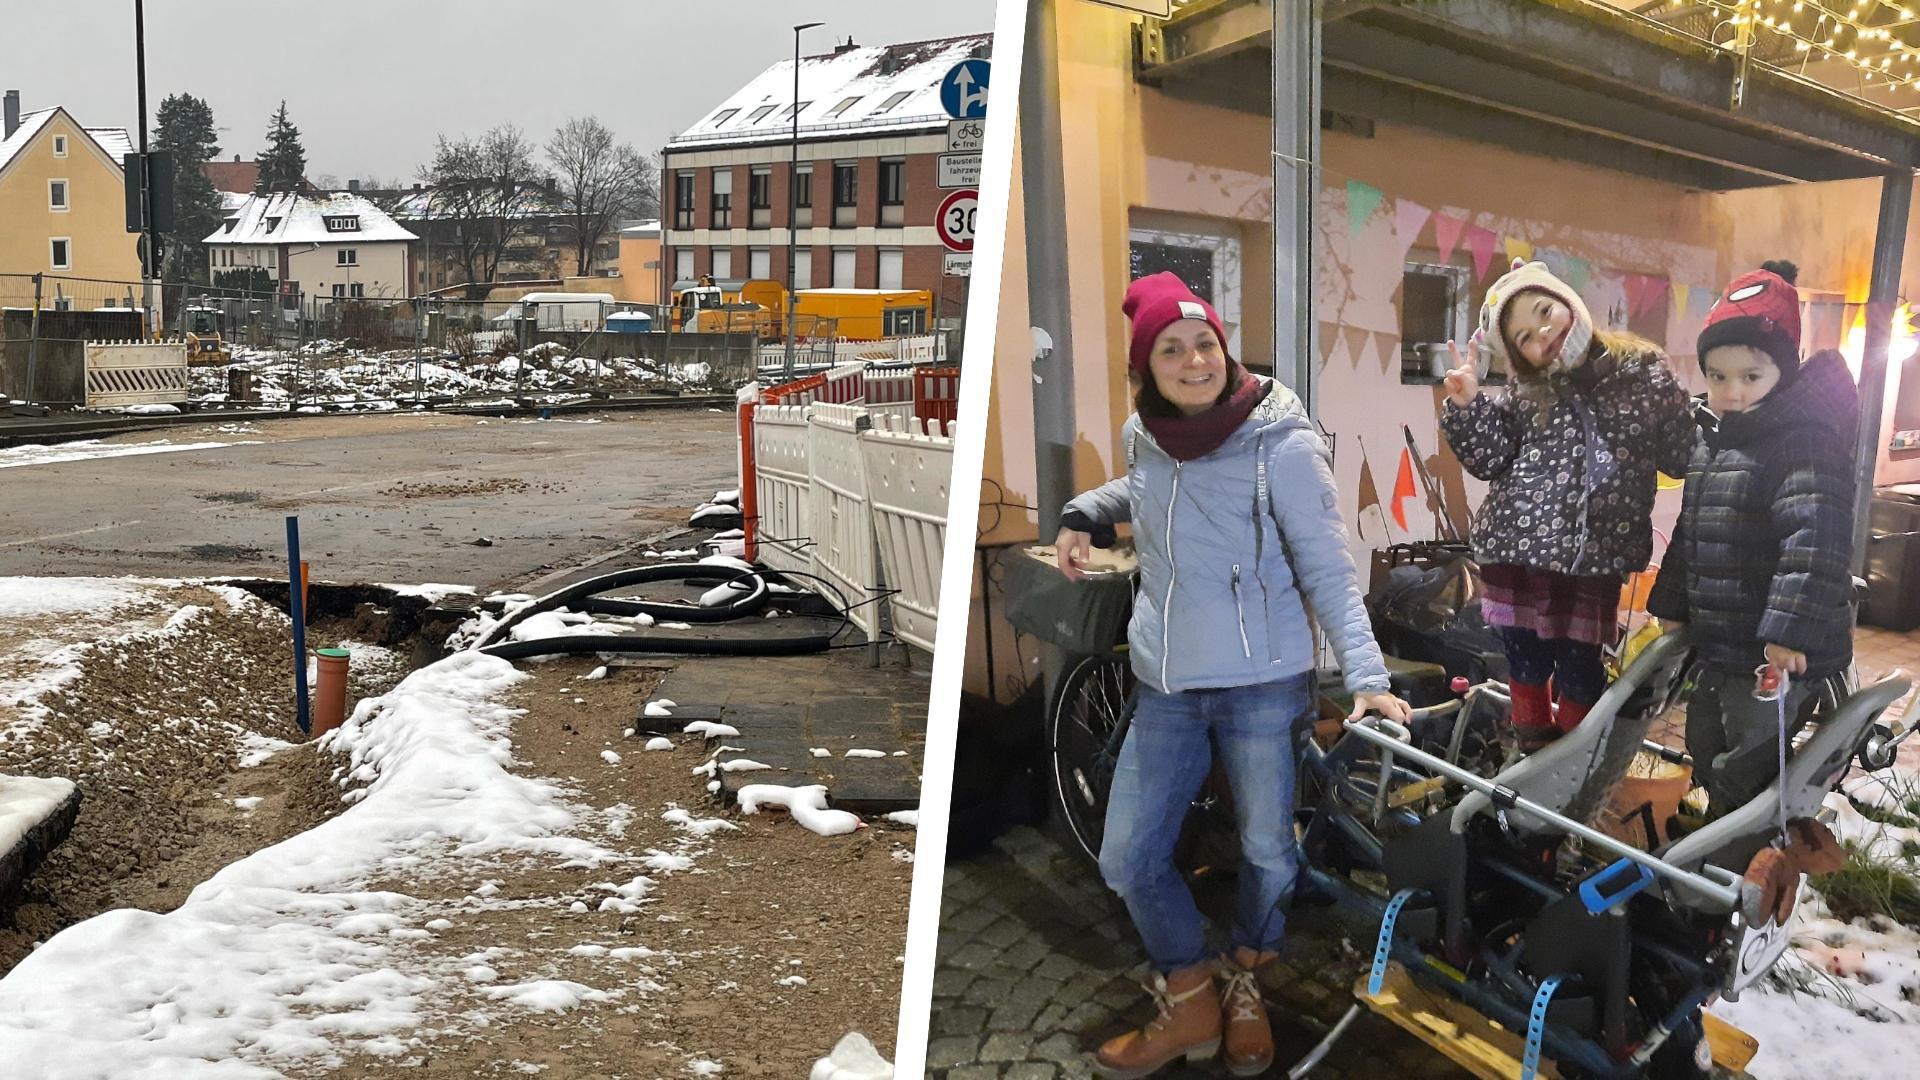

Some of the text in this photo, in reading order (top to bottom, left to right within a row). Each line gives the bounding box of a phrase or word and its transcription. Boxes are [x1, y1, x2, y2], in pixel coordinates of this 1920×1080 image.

[963, 140, 977, 148] frei
[949, 207, 977, 234] 30
[1257, 462, 1267, 500] STREET ONE
